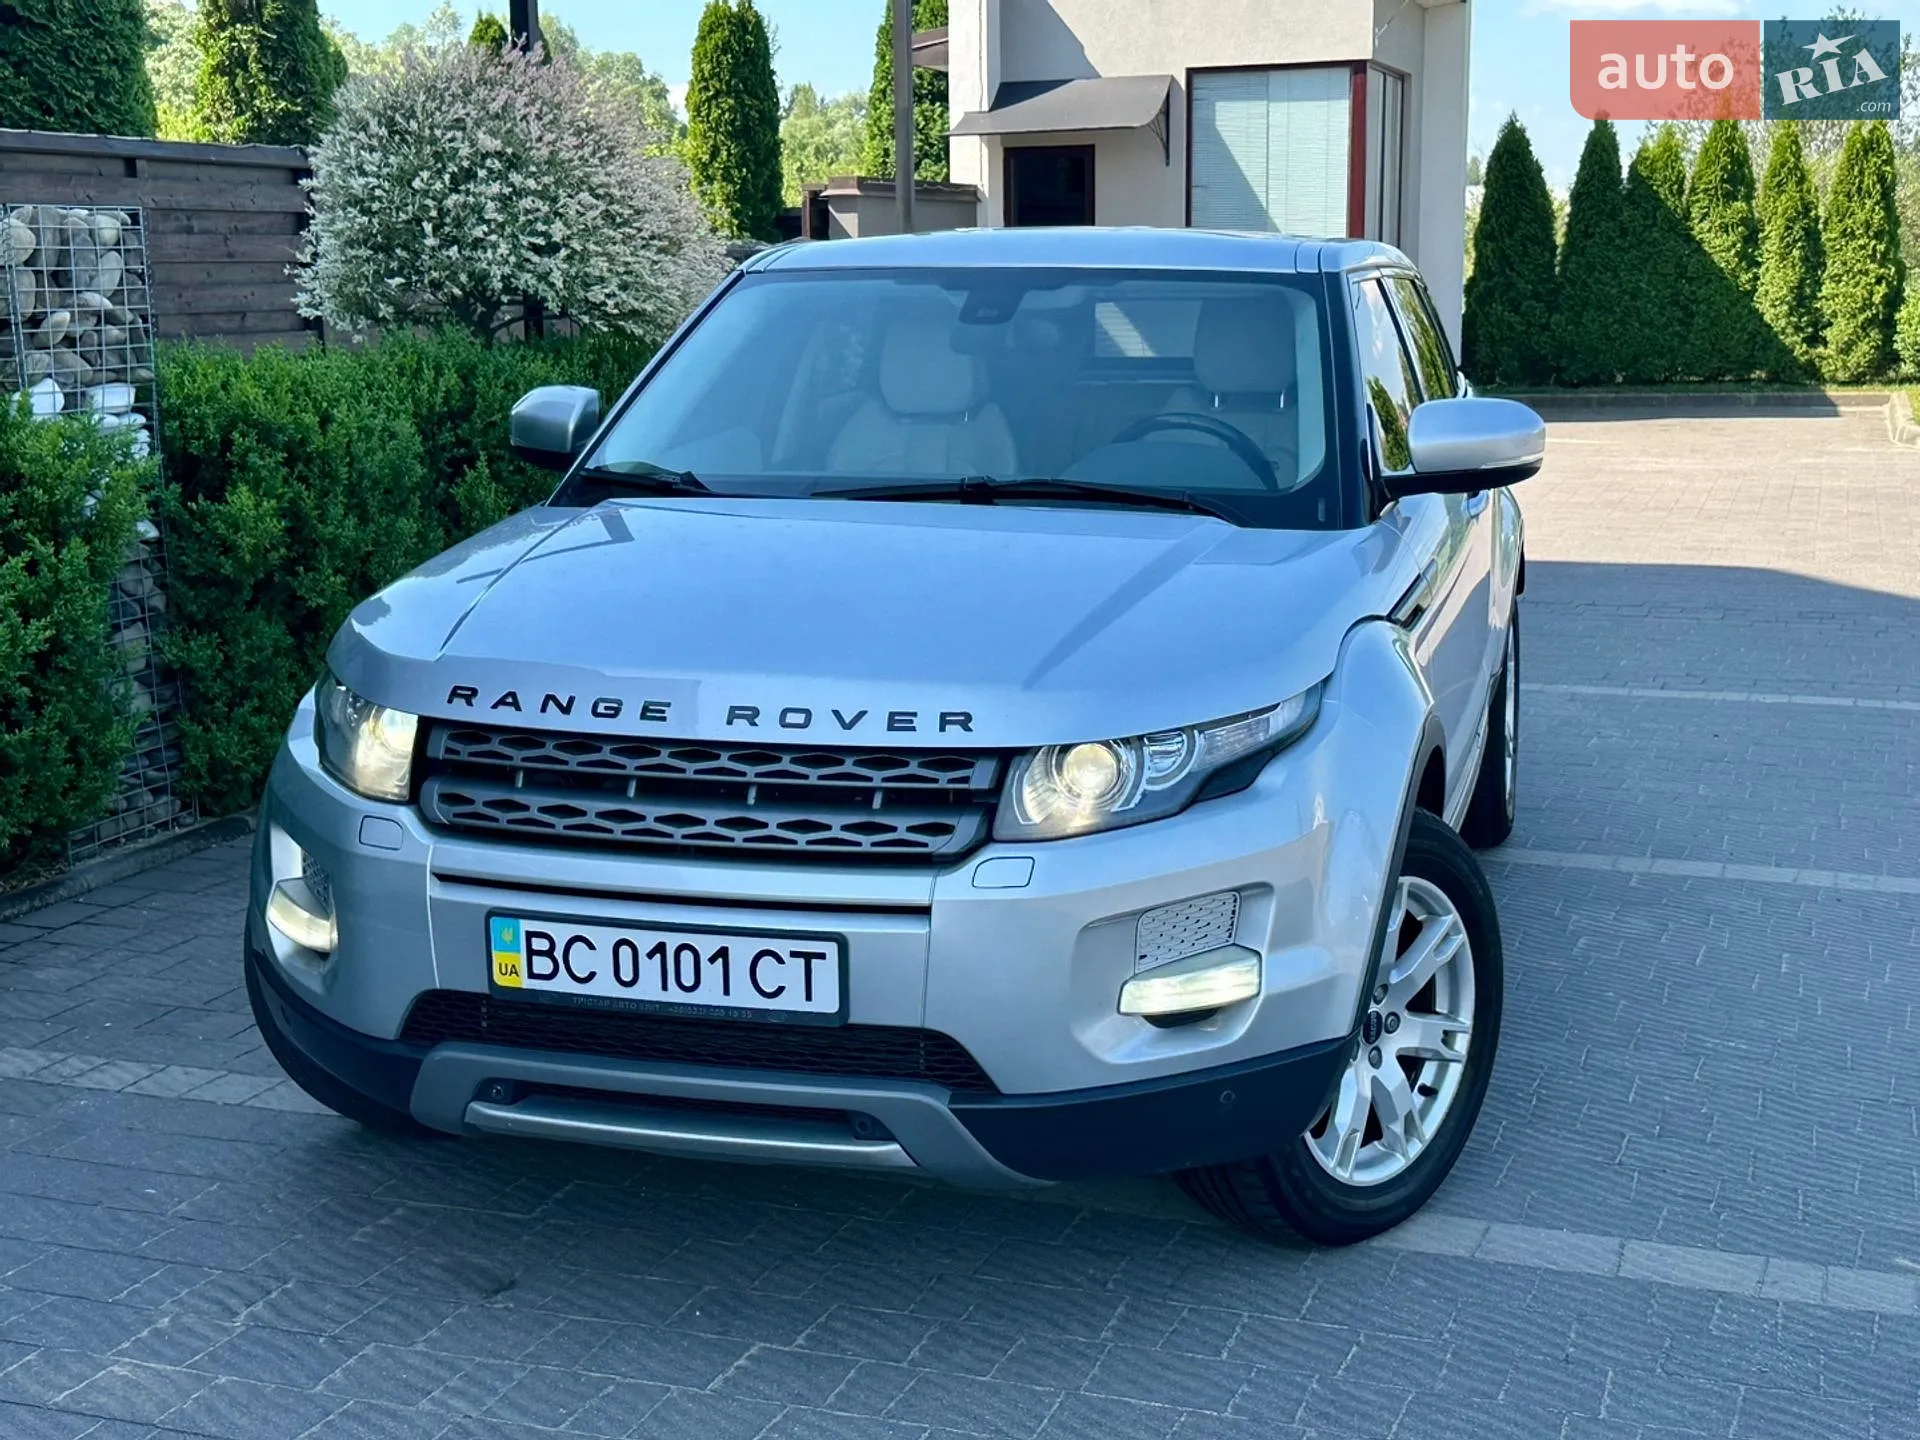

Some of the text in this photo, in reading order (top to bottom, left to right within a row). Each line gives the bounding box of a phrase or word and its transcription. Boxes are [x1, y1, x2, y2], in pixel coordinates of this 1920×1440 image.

[446, 685, 974, 732] RANGE ROVER
[498, 962, 520, 977] UA
[525, 930, 827, 1002] BC 0101 CT
